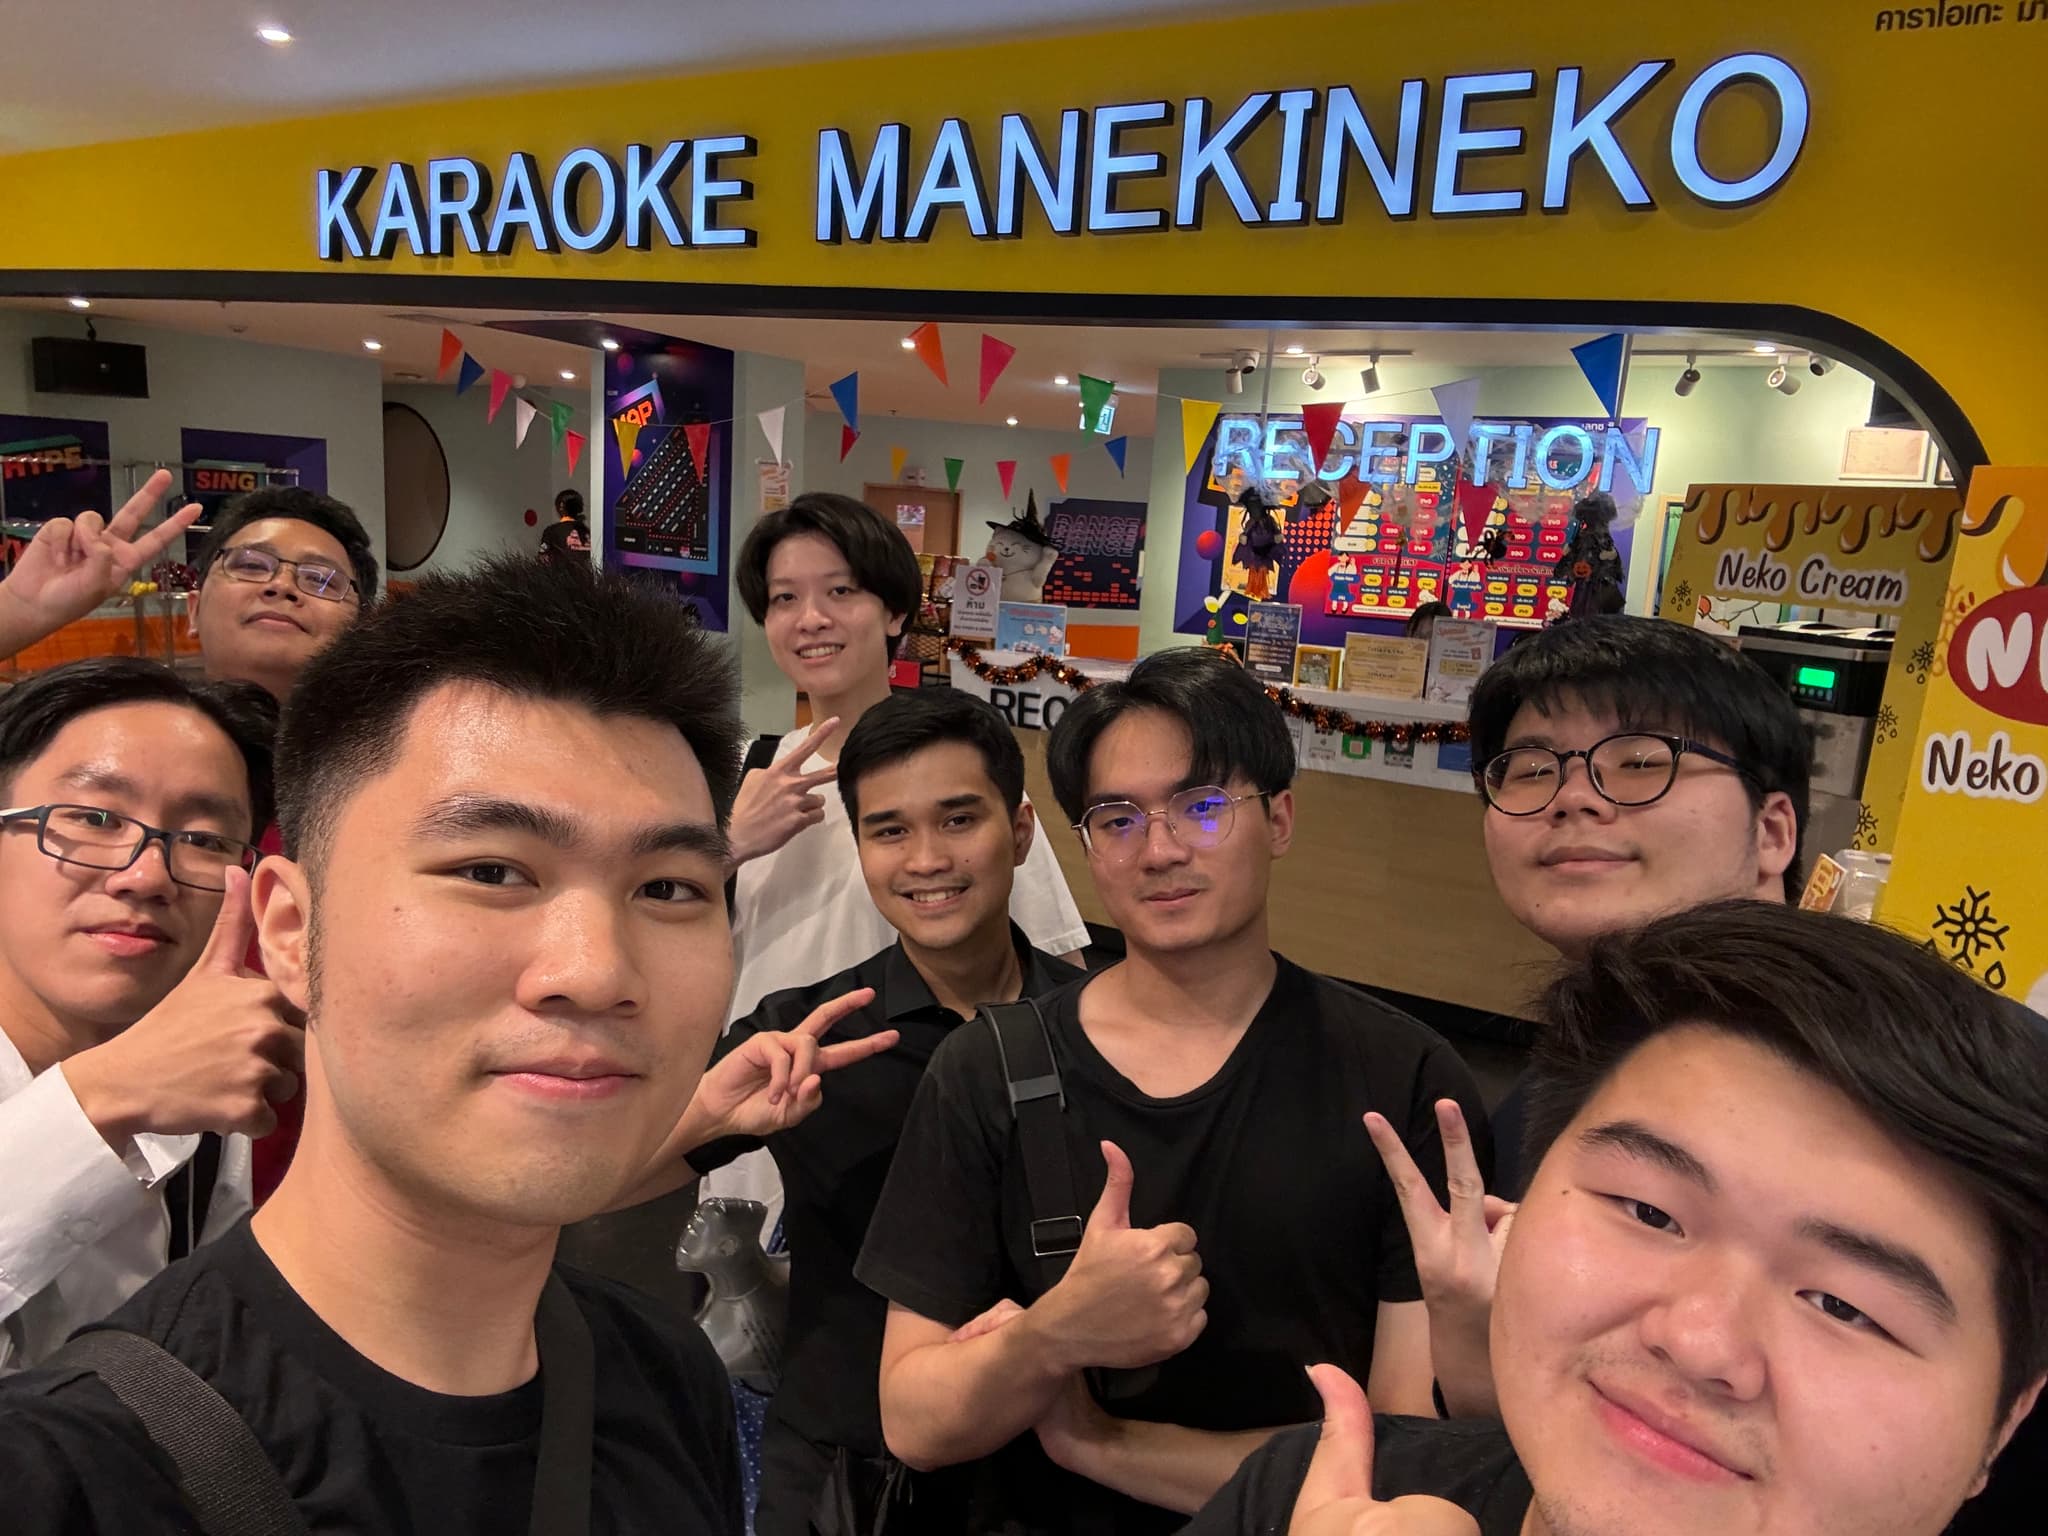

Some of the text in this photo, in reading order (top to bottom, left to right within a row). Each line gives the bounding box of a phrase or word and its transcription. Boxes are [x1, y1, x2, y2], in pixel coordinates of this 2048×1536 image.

[1875, 0, 2003, 31] คาราโอเกะ
[318, 52, 1811, 261] KARAOKE MANEKINEKO
[4, 446, 82, 478] HYPE
[196, 470, 255, 491] SING
[1216, 418, 1661, 493] RECEPTION
[1718, 552, 1903, 601] Neko Cream
[1966, 611, 2048, 694] N
[1928, 738, 2040, 795] Neko
